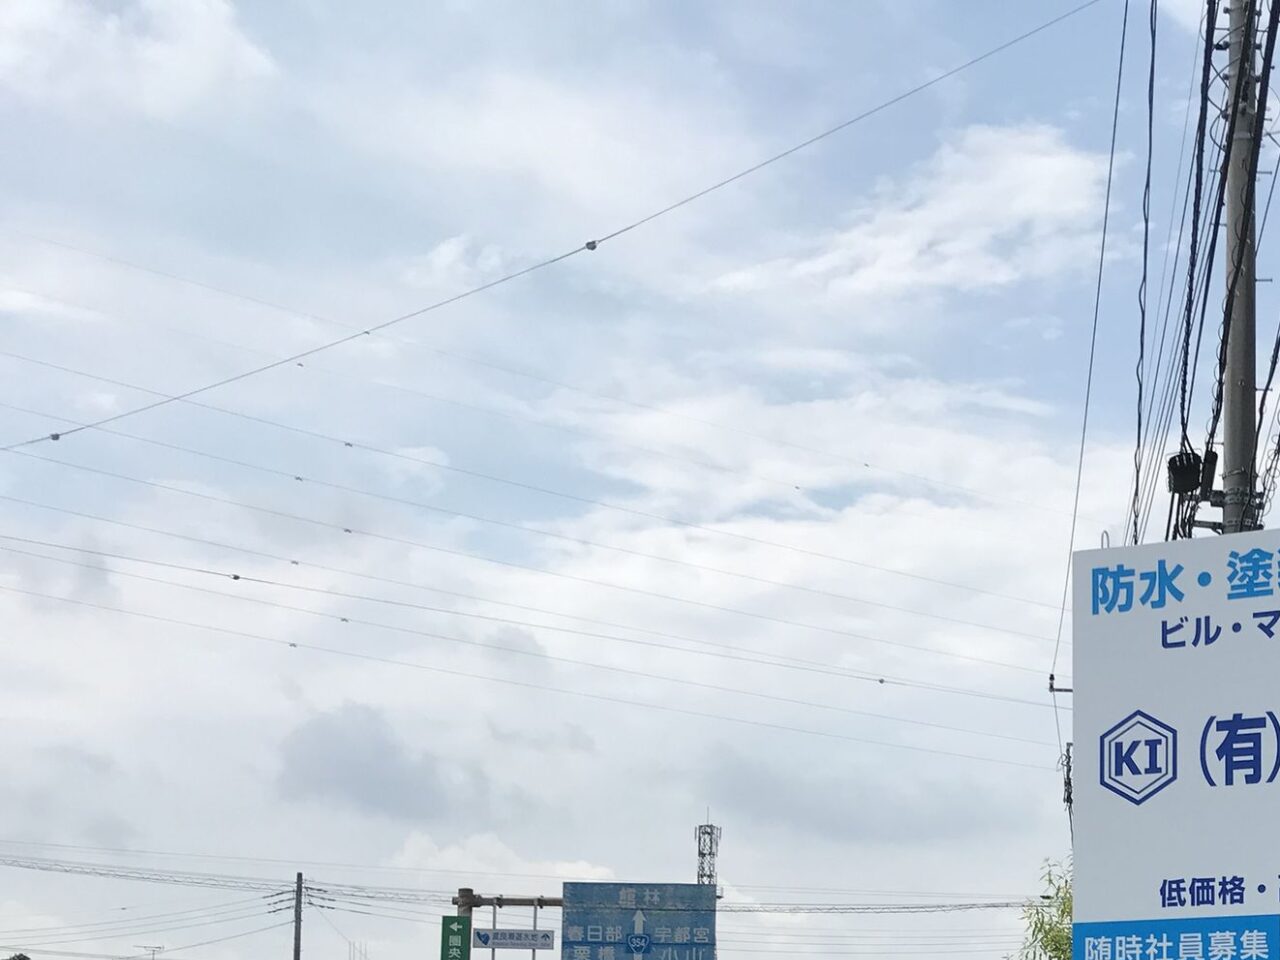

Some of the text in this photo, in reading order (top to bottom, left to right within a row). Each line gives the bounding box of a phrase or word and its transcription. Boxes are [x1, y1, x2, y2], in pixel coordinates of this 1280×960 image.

[1114, 738, 1163, 777] KI
[567, 925, 622, 942] 春日部
[631, 937, 646, 947] 354
[655, 926, 710, 943] 宇都宮
